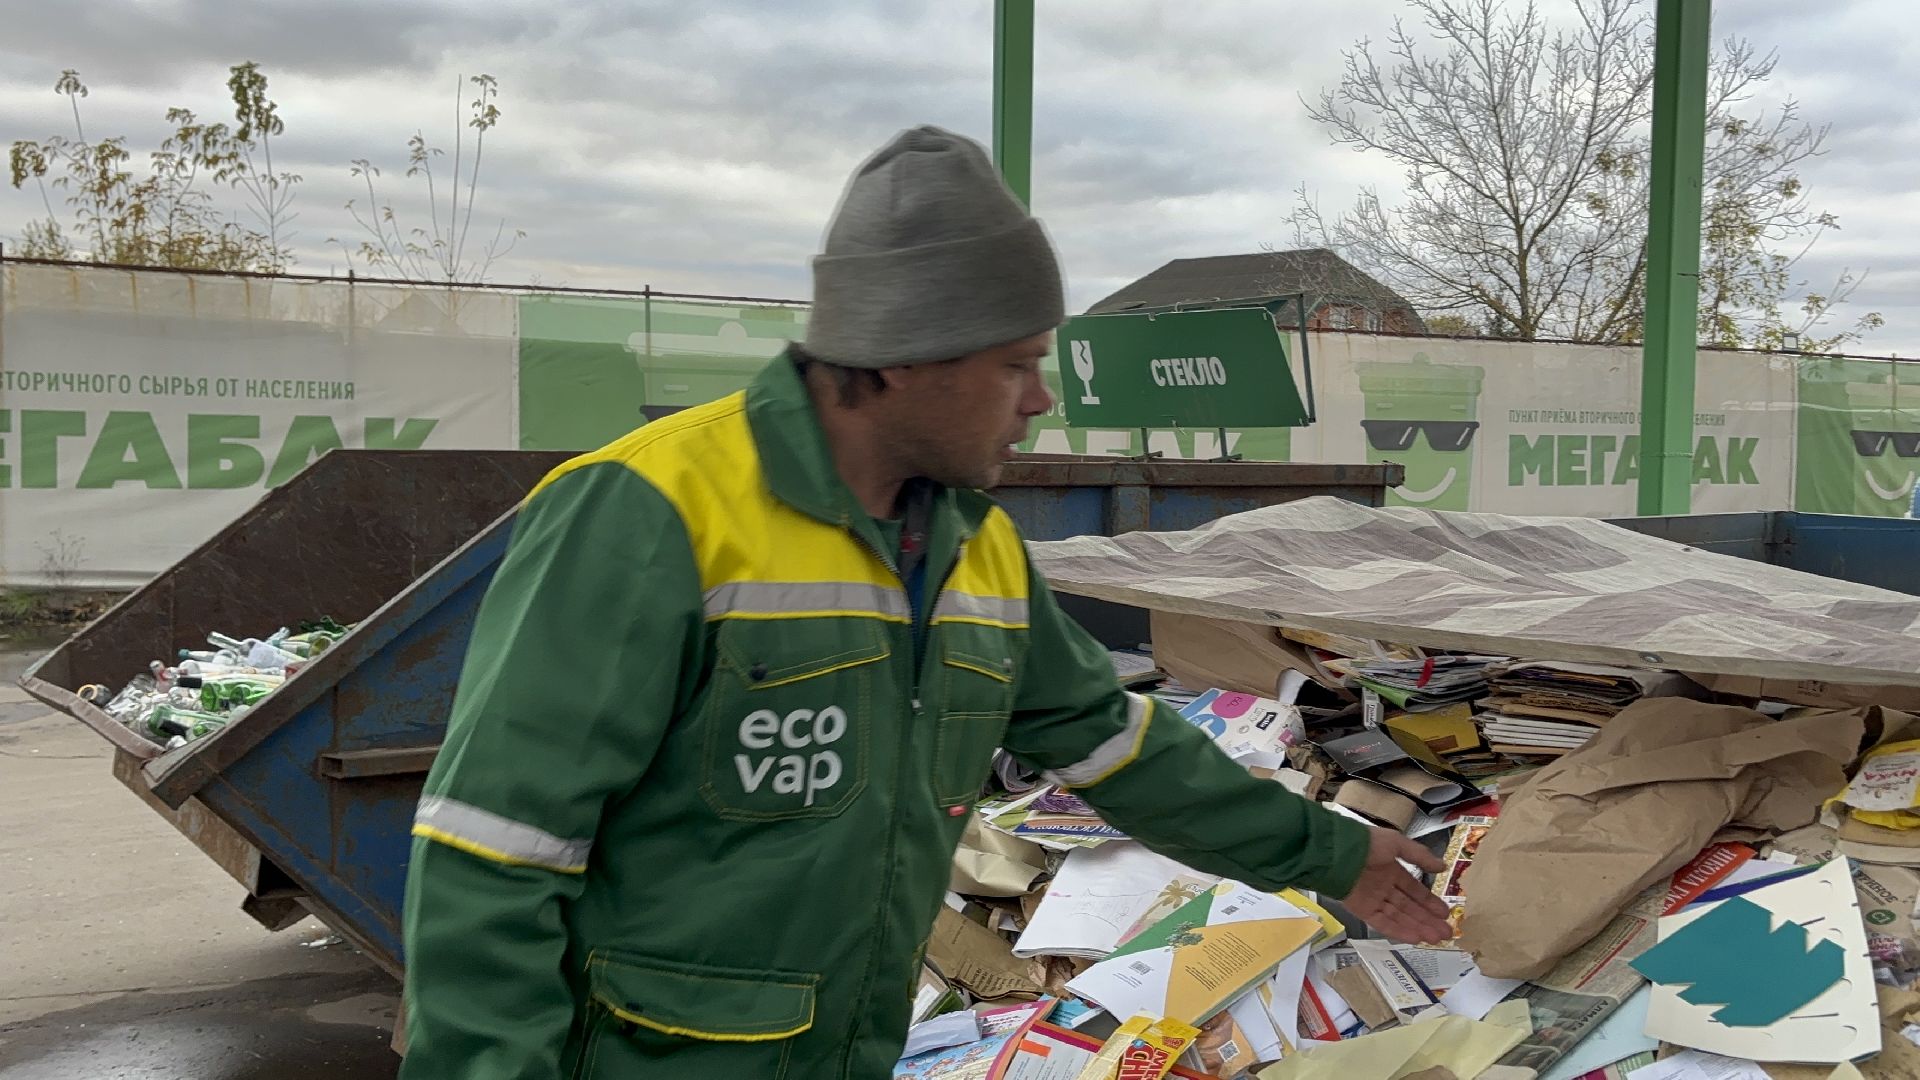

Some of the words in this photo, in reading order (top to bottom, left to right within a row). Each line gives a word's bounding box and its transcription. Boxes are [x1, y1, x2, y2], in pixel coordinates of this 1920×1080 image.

[139, 375, 208, 397] СЫРЬЯ
[216, 378, 239, 397] ОТ
[246, 379, 356, 400] НАСЕЛЕНИЯ
[1151, 356, 1227, 387] СТЕКЛО
[1508, 409, 1539, 423] ПУНКТ
[1541, 408, 1577, 424] ПРИЁМА
[1579, 411, 1636, 425] ВТОРИЧНОГО
[1507, 434, 1761, 486] МЕГААК
[738, 705, 848, 749] eco
[734, 750, 843, 807] vap
